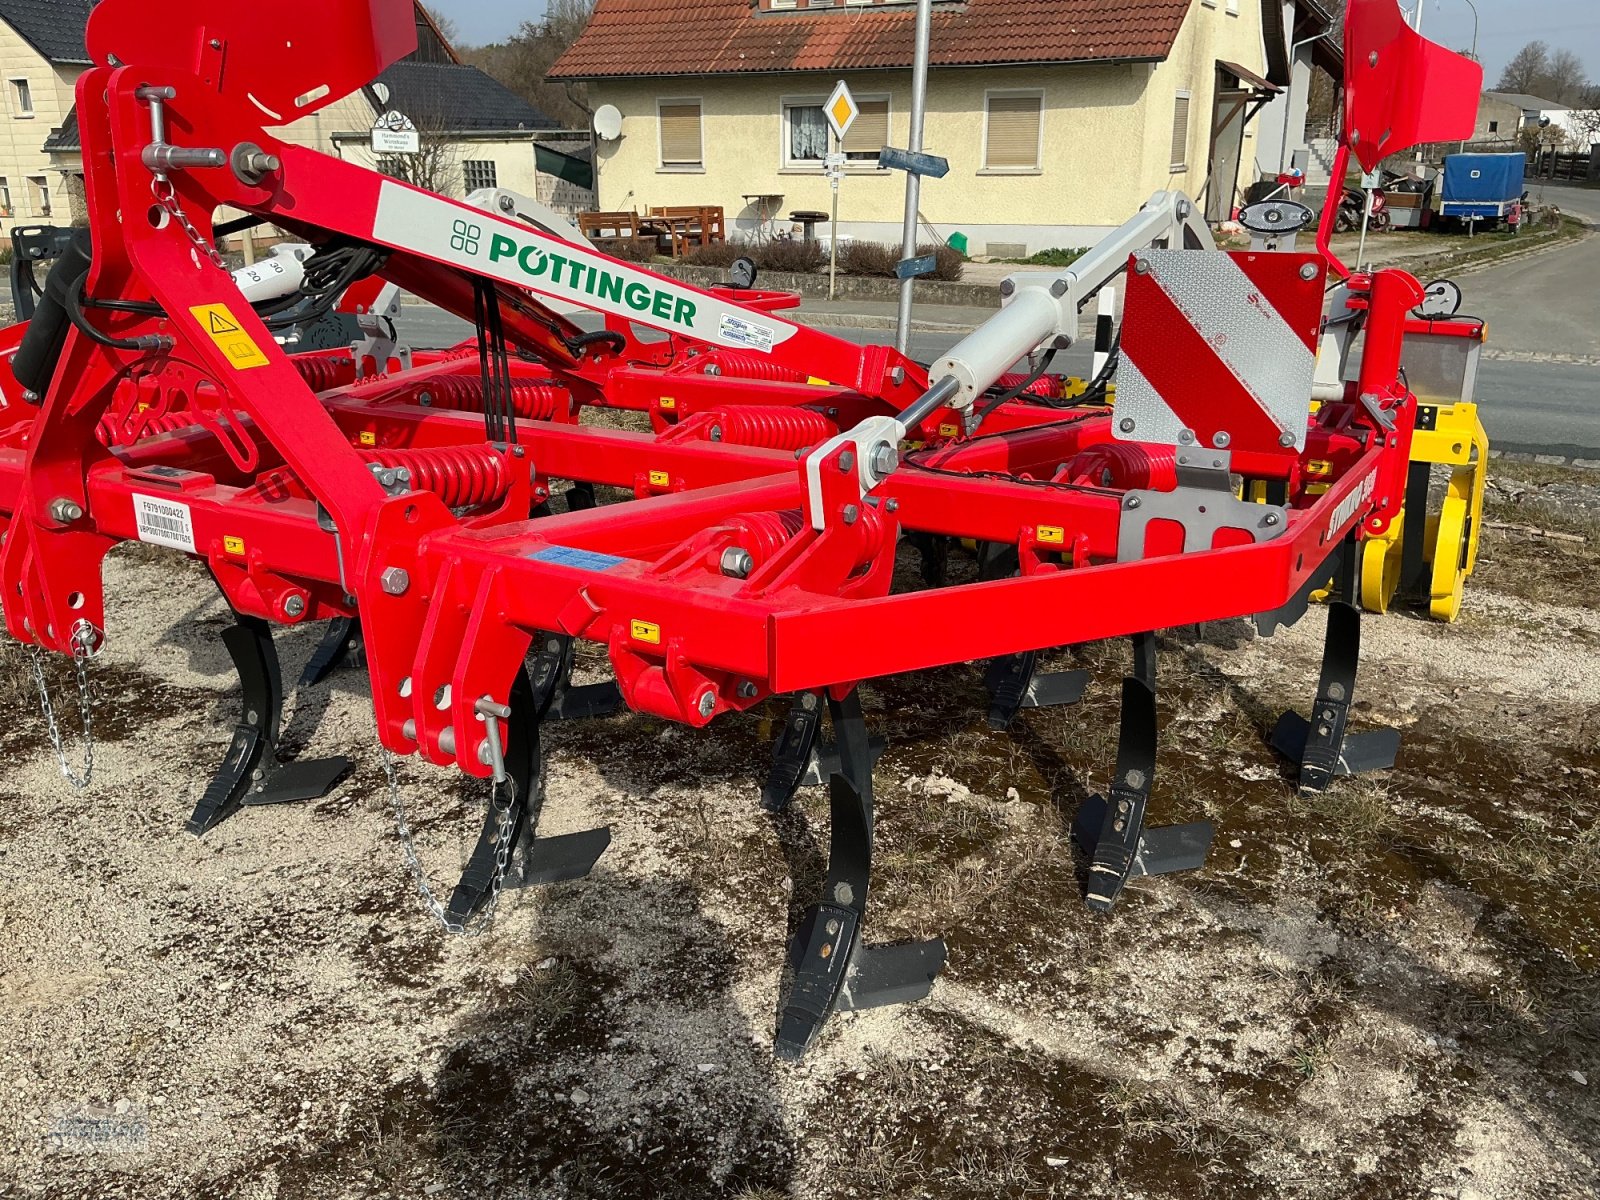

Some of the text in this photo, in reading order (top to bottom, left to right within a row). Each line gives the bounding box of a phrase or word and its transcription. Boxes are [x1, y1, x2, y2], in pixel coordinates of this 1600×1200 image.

[269, 262, 284, 273] 30
[247, 270, 261, 282] 20
[489, 233, 697, 327] PÖTTINGER
